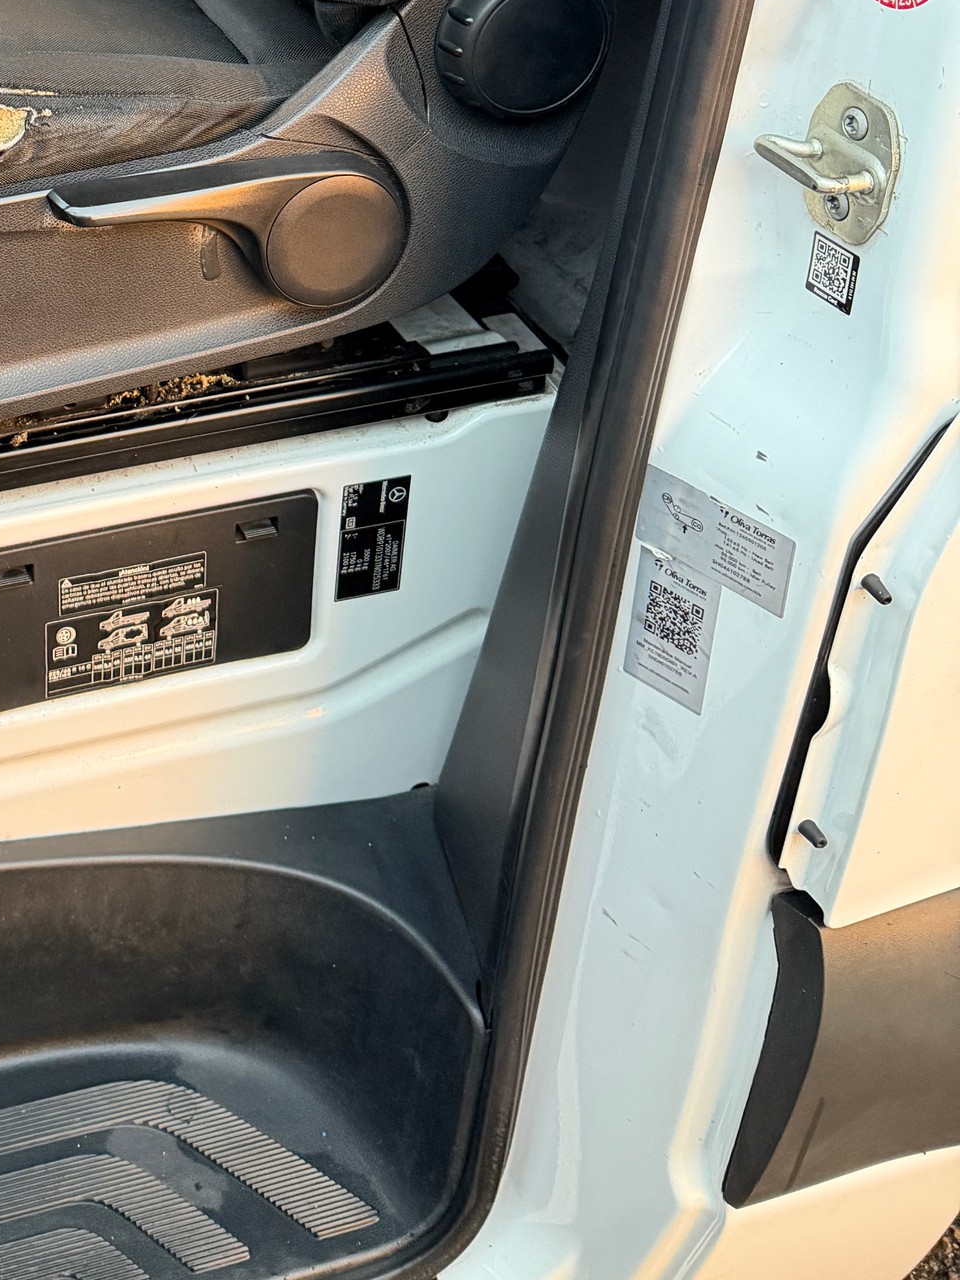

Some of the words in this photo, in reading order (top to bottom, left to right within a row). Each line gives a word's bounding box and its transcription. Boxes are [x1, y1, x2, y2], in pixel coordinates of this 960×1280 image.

[730, 514, 751, 532] Oliva
[752, 525, 776, 545] Torras
[349, 551, 357, 565] 1750
[363, 548, 371, 562] 3500
[390, 540, 399, 563] DAIMLER
[342, 552, 350, 566] 2100
[390, 563, 397, 572] AG
[664, 568, 684, 584] Oliva
[685, 578, 707, 597] Torras
